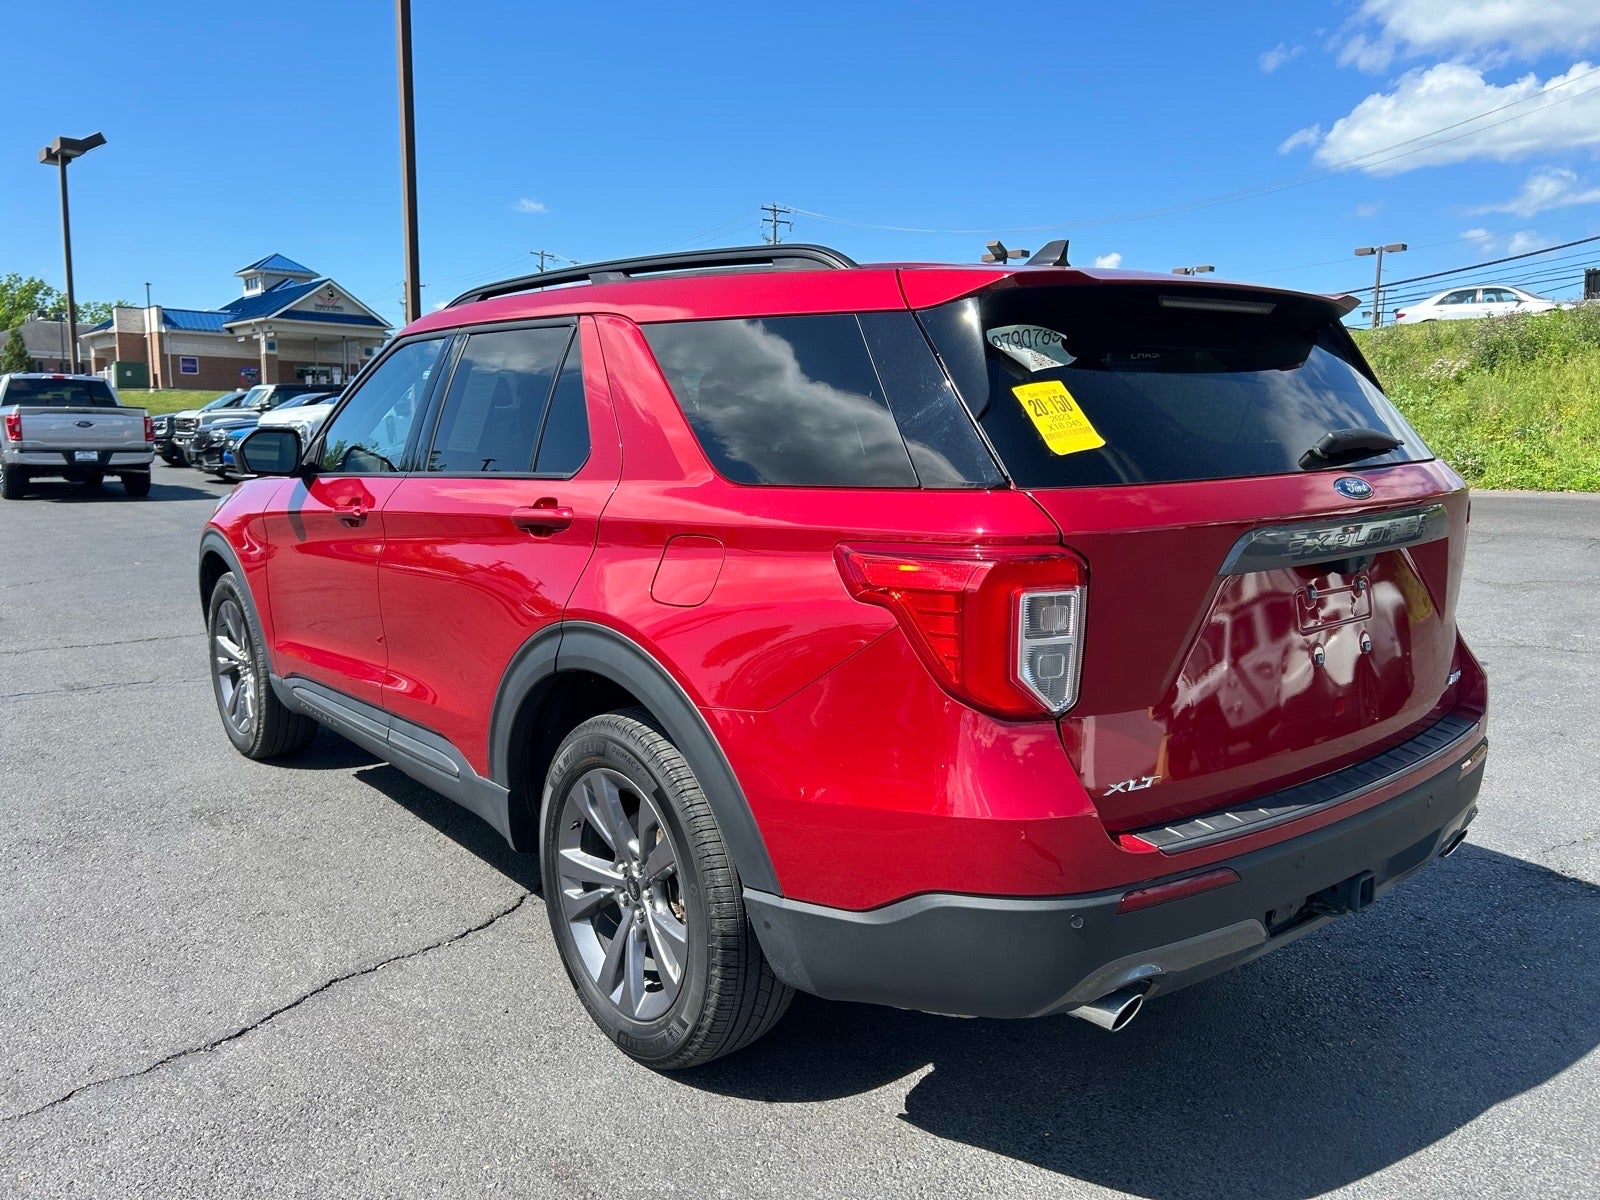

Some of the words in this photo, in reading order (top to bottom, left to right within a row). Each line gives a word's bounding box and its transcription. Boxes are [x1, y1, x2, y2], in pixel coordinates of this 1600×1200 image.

[1049, 413, 1072, 423] 2023
[1287, 517, 1427, 554] EXPLORER
[1103, 775, 1162, 797] XLT
